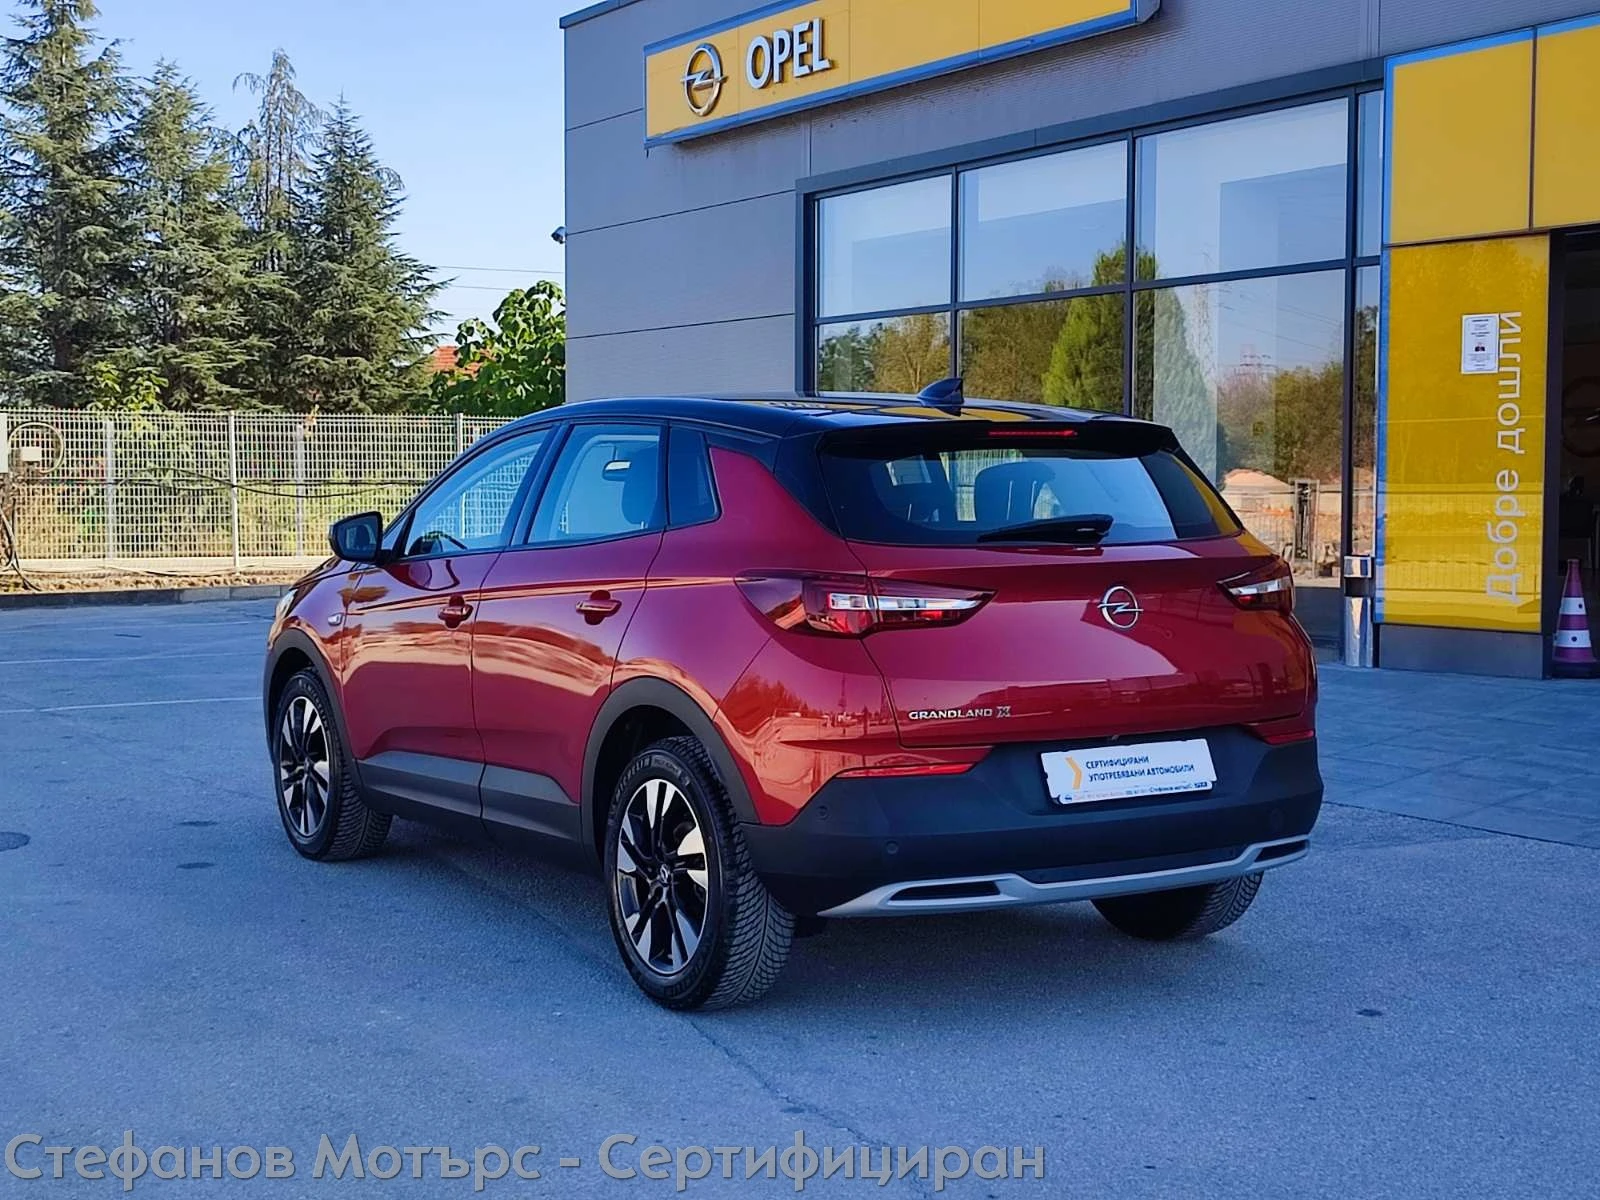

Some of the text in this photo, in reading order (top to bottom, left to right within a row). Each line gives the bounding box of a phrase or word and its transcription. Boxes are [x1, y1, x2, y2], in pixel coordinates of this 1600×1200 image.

[746, 17, 832, 89] OPEL
[1486, 311, 1526, 605] Добре дошли
[908, 705, 1012, 720] GRANDLAND X
[1085, 756, 1149, 769] СЕРТИФИЦИРАНИ
[1088, 764, 1195, 782] УПОТРЕБЯВАНИ АВТОМОБИЛИ
